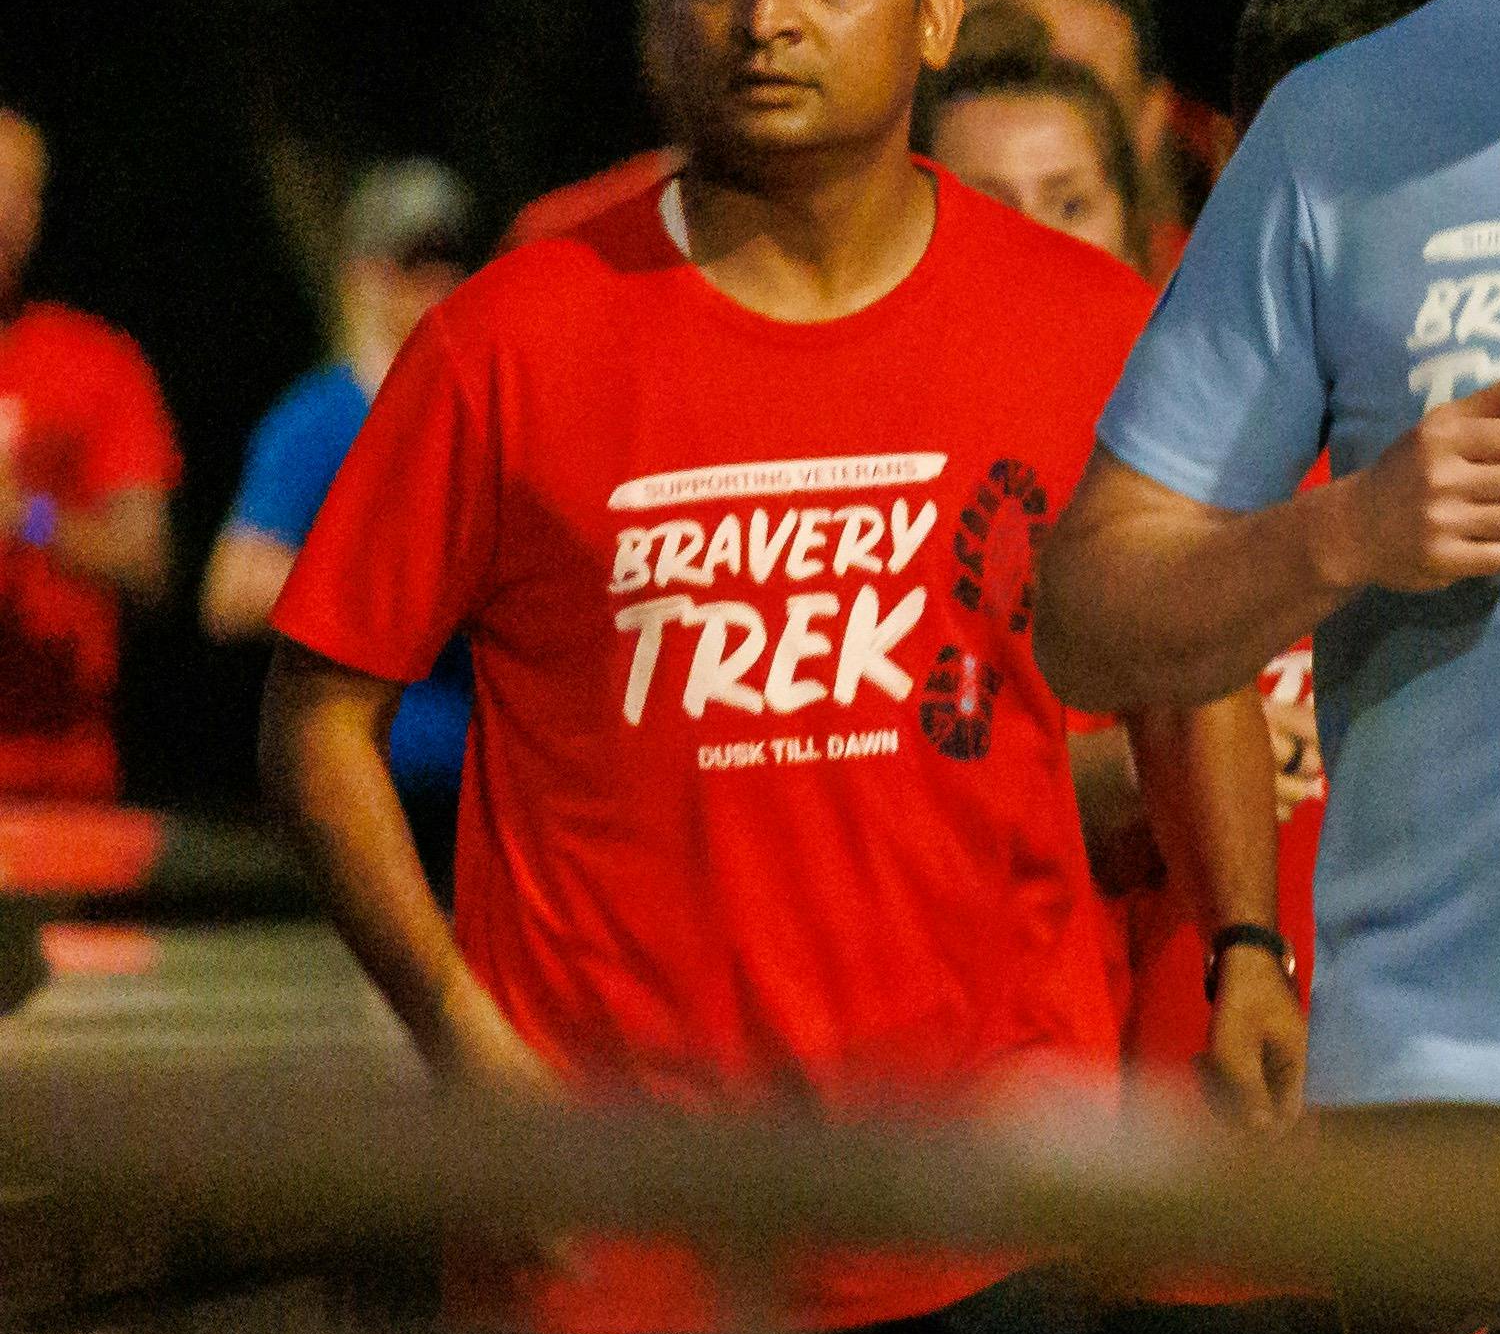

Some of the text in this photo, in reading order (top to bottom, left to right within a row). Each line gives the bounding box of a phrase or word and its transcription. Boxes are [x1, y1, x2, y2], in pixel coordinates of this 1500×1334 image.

[608, 498, 938, 593] BRAVERY
[615, 585, 927, 727] TREK
[698, 729, 899, 769] DUSK TILL DAWN
